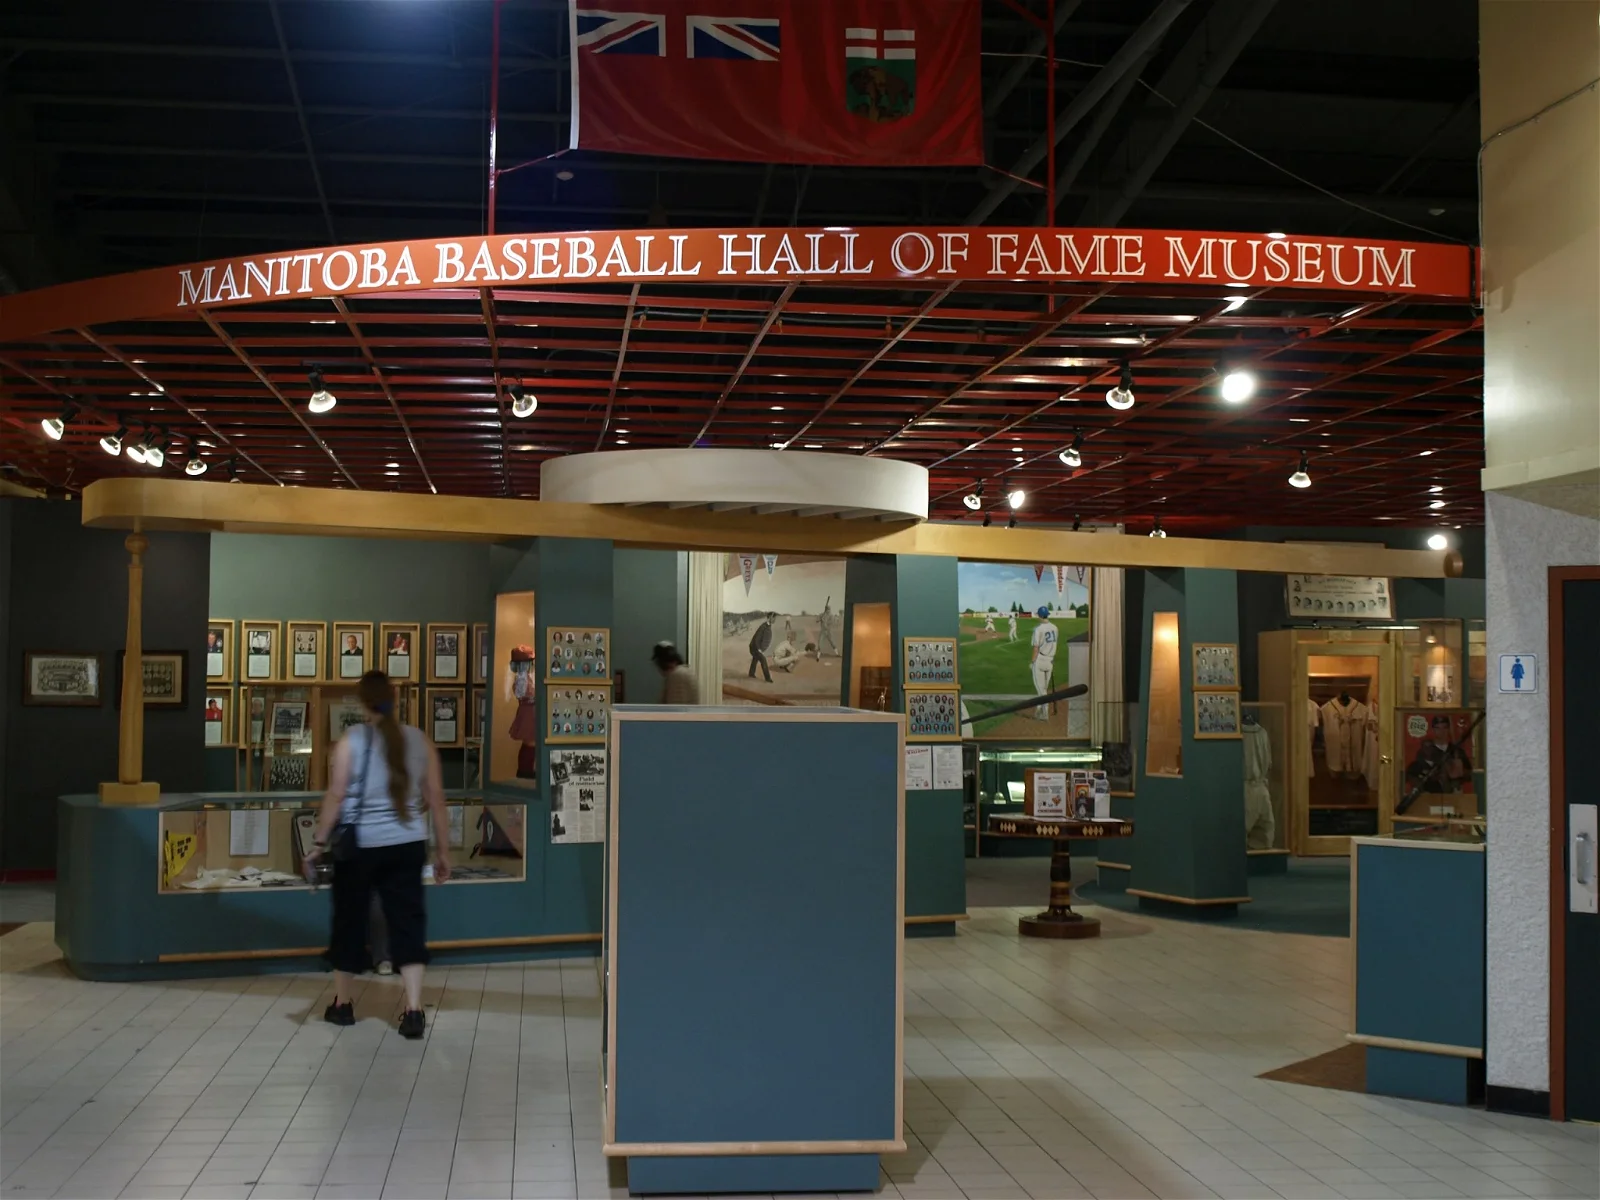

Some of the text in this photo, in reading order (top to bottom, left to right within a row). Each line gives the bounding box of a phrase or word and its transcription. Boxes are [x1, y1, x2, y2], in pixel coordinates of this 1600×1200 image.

[177, 231, 1416, 307] MANITOBA BASEBALL HALL OF FAME MUSEUM
[1045, 630, 1057, 643] 21
